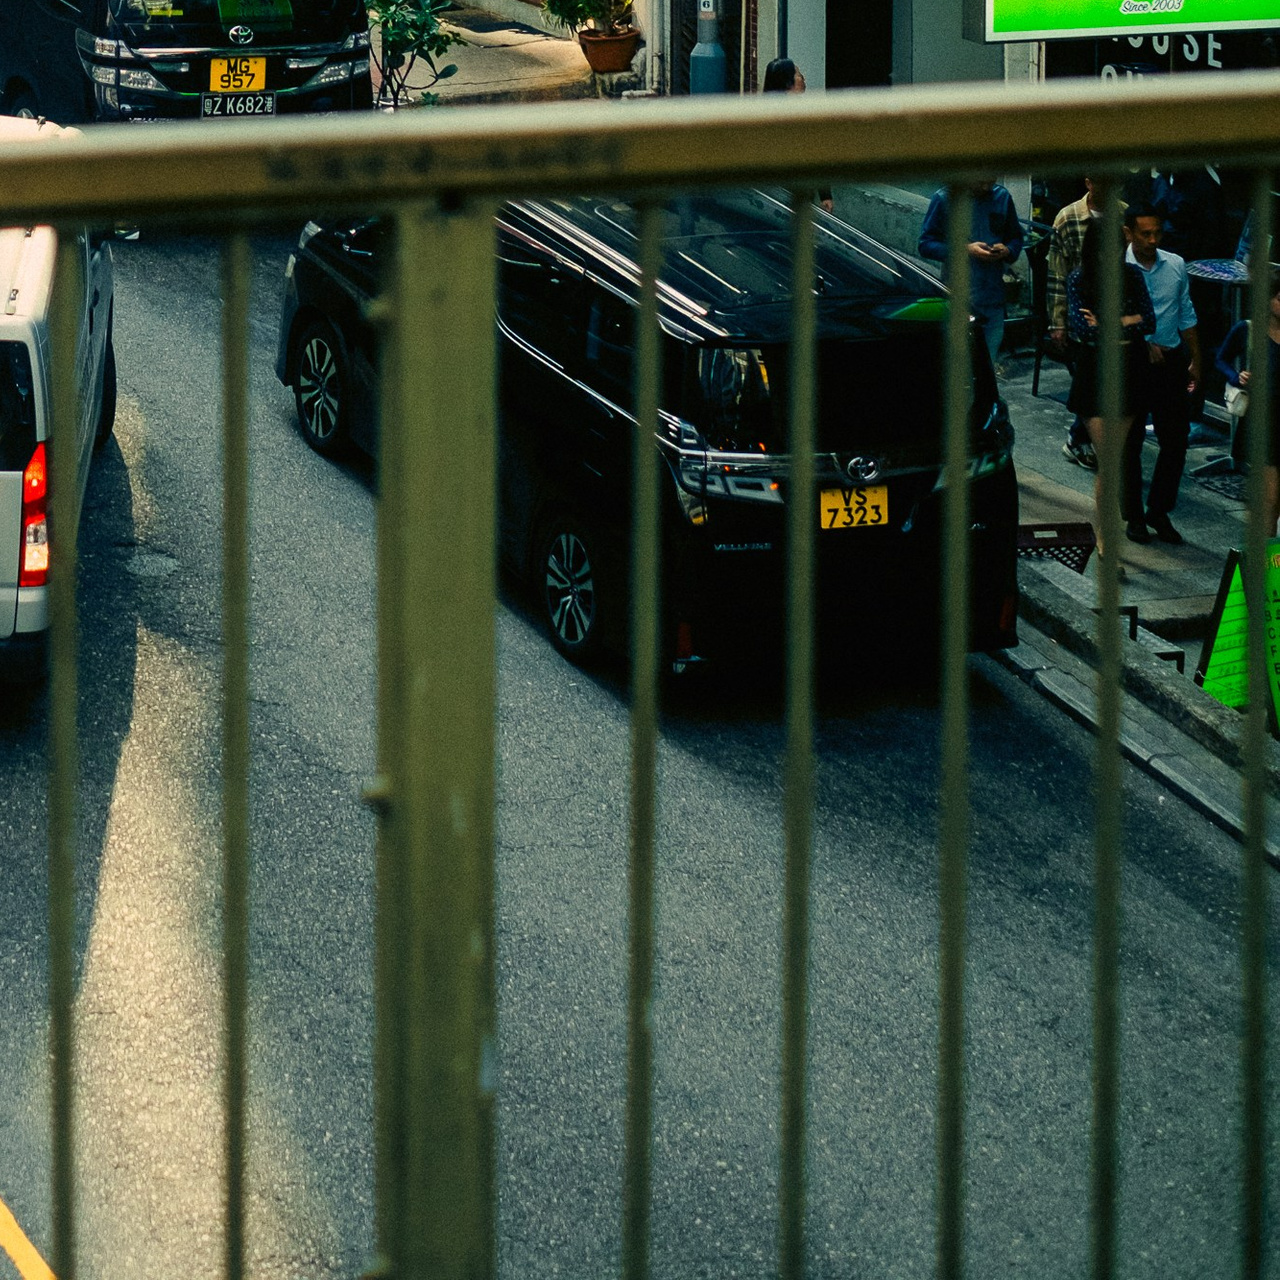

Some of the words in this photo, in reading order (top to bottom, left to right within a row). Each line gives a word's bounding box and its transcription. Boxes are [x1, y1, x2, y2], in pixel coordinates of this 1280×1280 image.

[1122, 0, 1148, 12] Since
[226, 59, 250, 74] MG
[220, 73, 256, 89] 957
[841, 490, 868, 506] VS
[827, 505, 883, 528] 7323
